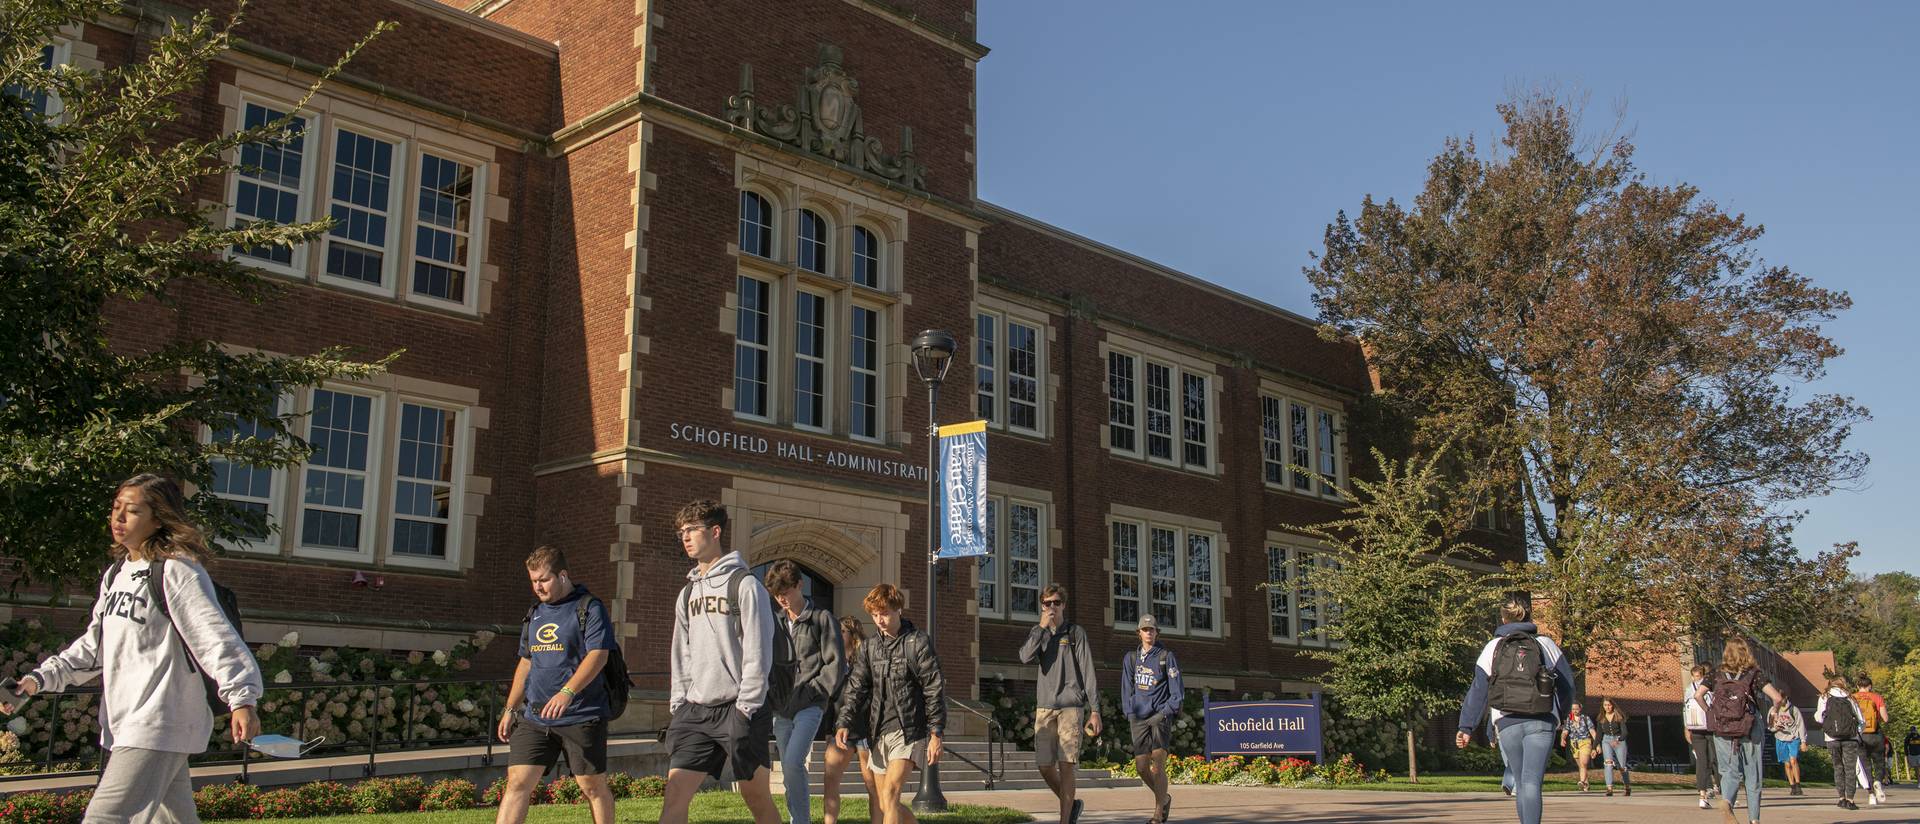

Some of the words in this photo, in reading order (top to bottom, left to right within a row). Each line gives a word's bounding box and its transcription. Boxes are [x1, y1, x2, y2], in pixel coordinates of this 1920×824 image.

[670, 422, 768, 454] SCHOFIELD
[777, 441, 814, 462] HALL
[951, 443, 967, 481] Eau
[967, 442, 975, 489] University
[950, 483, 967, 545] Claire
[967, 496, 975, 545] Wisconsin
[530, 643, 564, 653] FOOTBALL
[1218, 717, 1274, 732] Schofield
[1278, 717, 1305, 731] Hall
[1240, 742, 1250, 750] 105
[1250, 742, 1273, 750] Garfield
[1273, 742, 1285, 750] Ave
